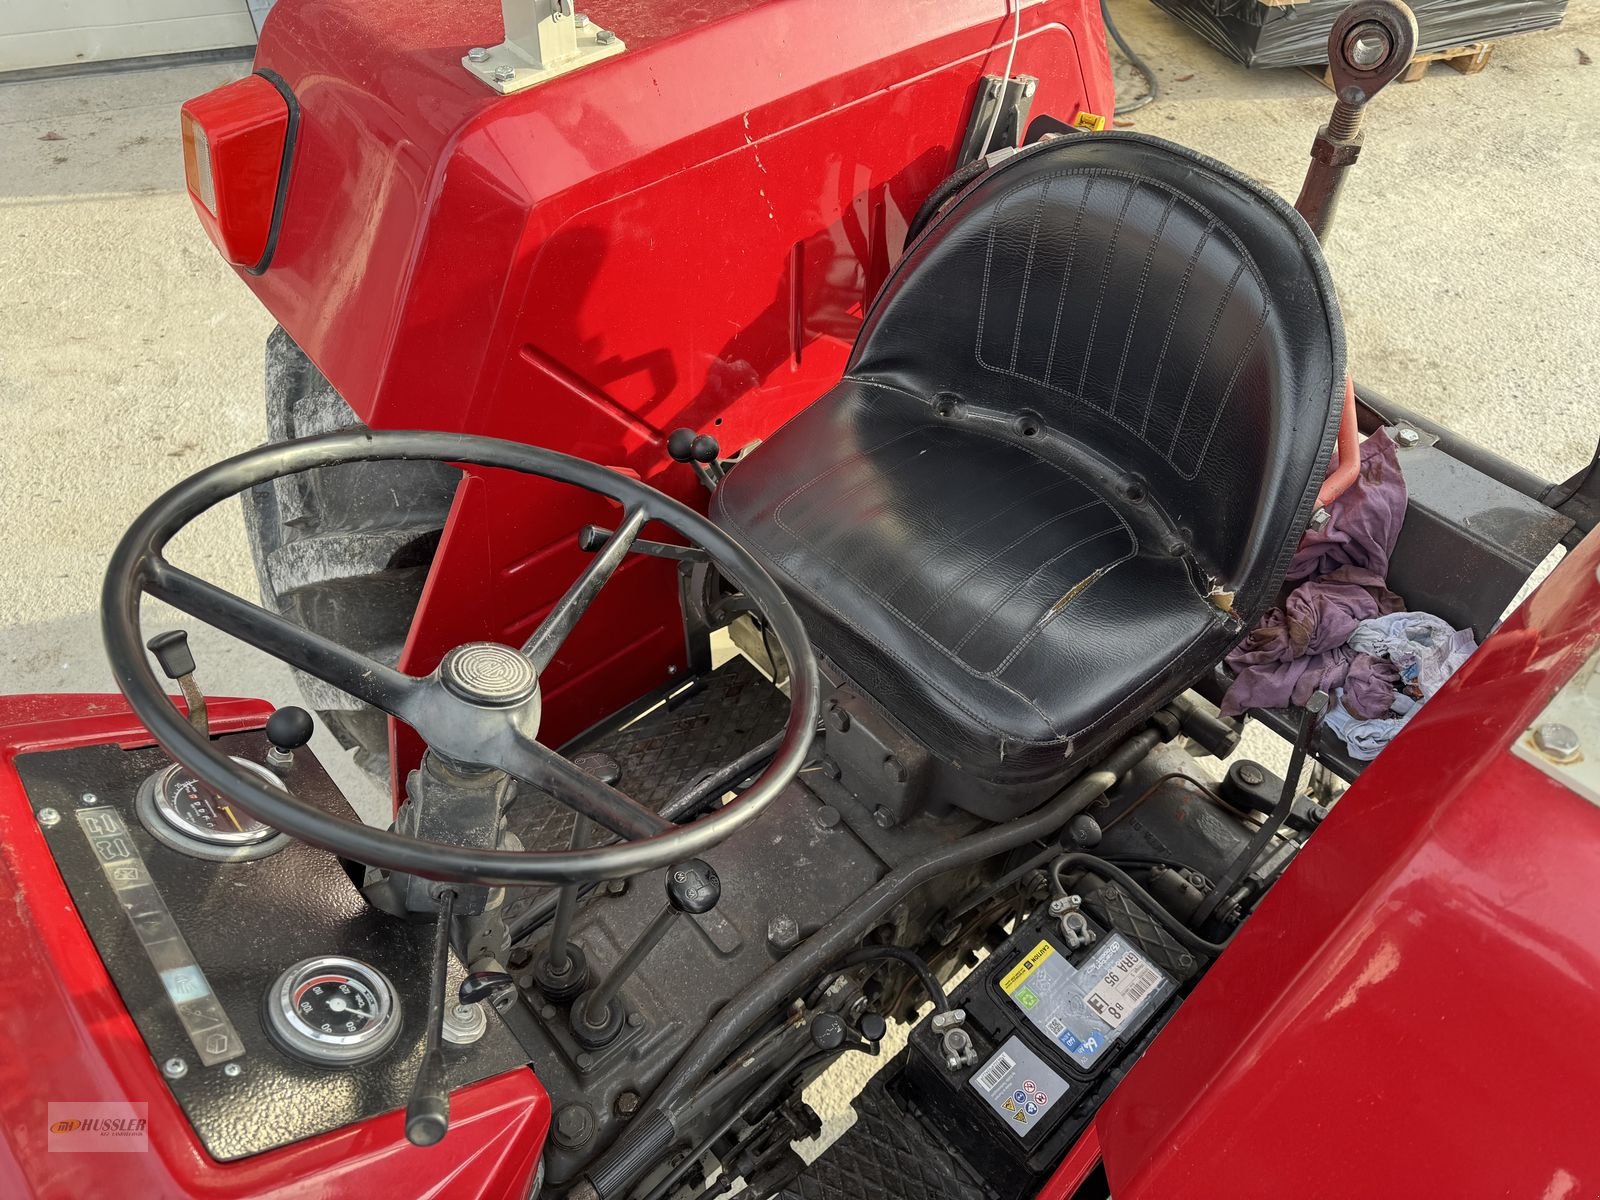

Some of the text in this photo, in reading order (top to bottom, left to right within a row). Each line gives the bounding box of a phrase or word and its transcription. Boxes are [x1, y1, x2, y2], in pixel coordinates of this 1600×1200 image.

[1031, 944, 1050, 963] CAUTION
[1116, 951, 1140, 975] GRA
[1103, 971, 1120, 988] 95
[1107, 1002, 1124, 1021] B 8
[1082, 1036, 1100, 1054] 64
